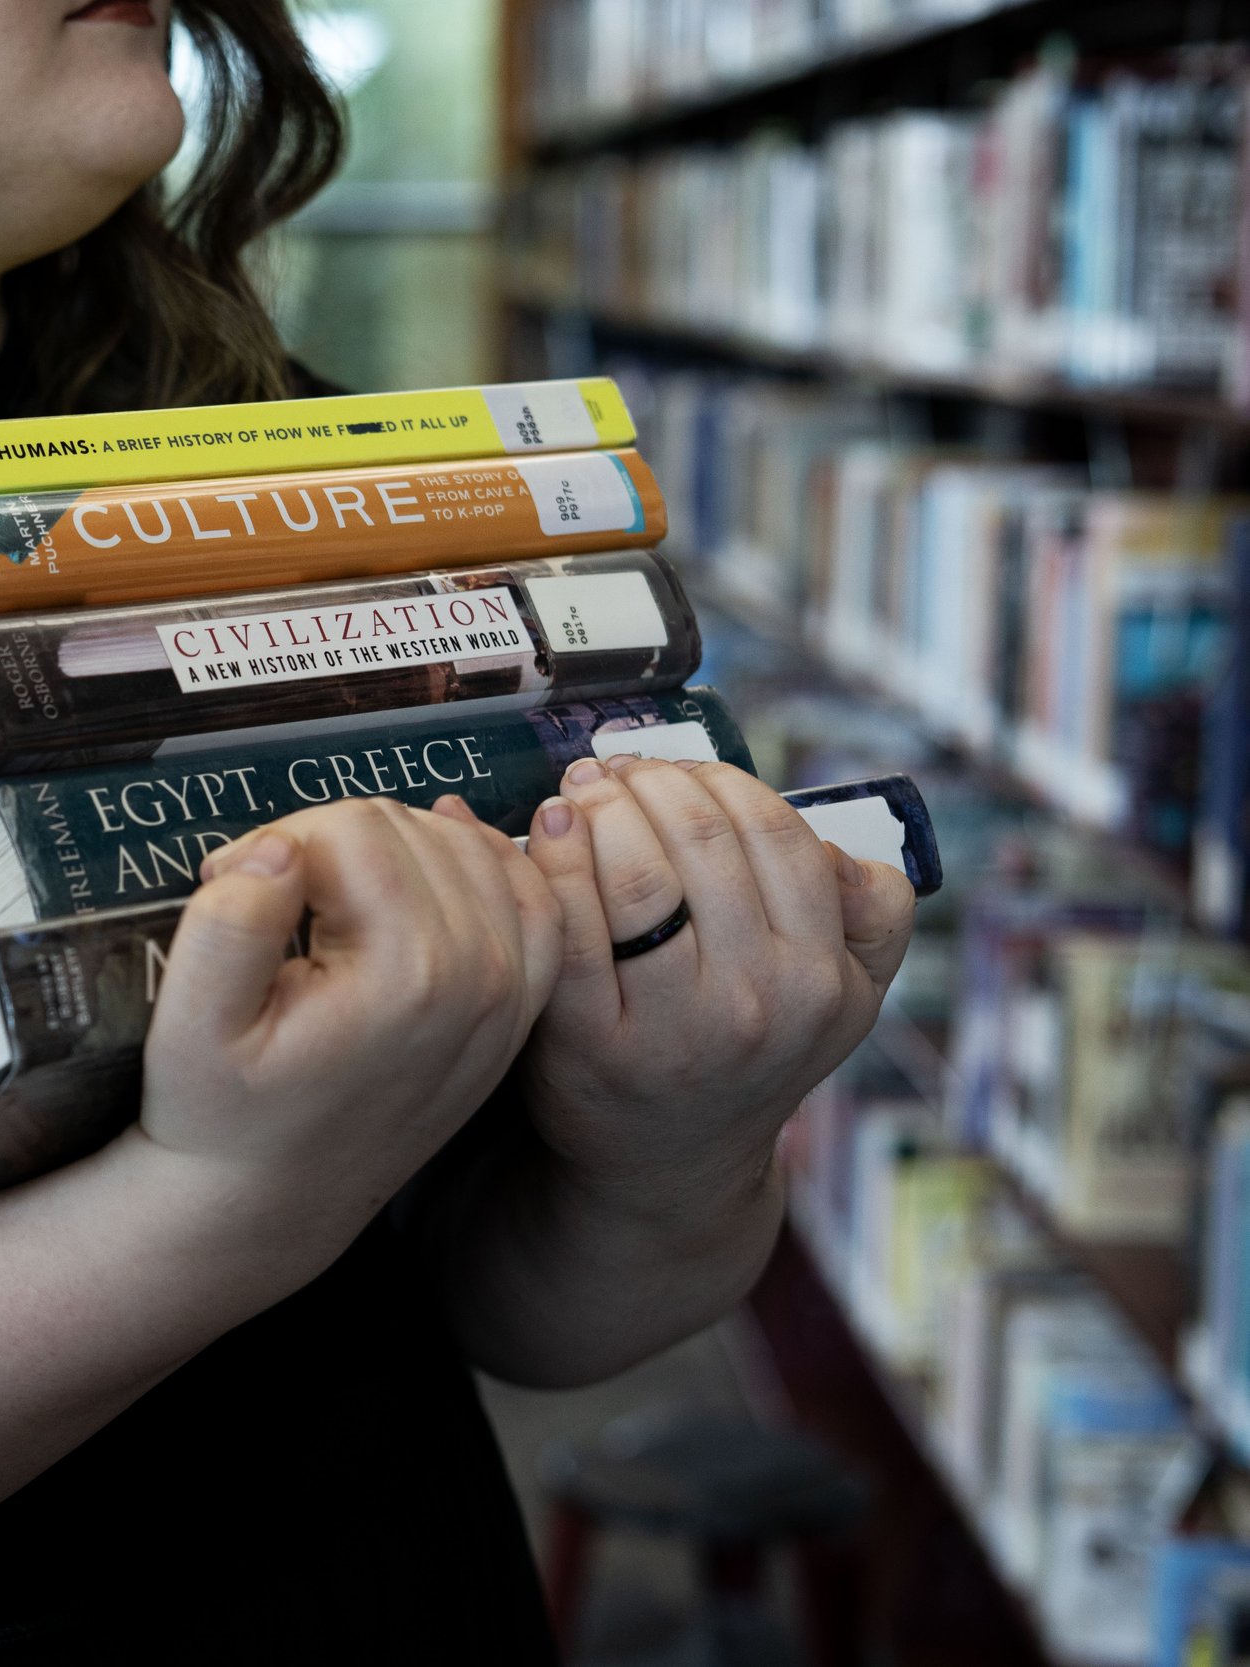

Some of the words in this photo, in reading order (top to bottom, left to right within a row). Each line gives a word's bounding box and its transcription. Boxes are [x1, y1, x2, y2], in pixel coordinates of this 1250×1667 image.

[103, 440, 115, 453] A
[117, 436, 162, 452] BRIEF
[166, 431, 233, 449] HISTORY
[237, 430, 259, 443] OF
[264, 426, 303, 442] HOW
[307, 424, 333, 439] WE
[337, 420, 398, 437] FED
[401, 419, 415, 432] IT
[420, 417, 447, 430] ALL
[449, 415, 469, 428] UP
[516, 422, 533, 445] 909
[415, 475, 450, 487] THE
[452, 470, 502, 485] STORY
[506, 470, 519, 481] O
[425, 489, 471, 503] FROM
[474, 485, 515, 499] CAVE
[5, 501, 41, 566] MARTIN
[18, 495, 60, 574] PUCHNER
[72, 481, 426, 549] CULTURE
[431, 508, 453, 521] TO
[457, 504, 505, 519] K-POP
[556, 496, 570, 521] 909
[173, 596, 510, 658] CIVILIZATION
[562, 622, 578, 645] 909
[12, 632, 59, 719] OSBORNE
[188, 666, 201, 684] A
[205, 661, 242, 681] NEW
[248, 652, 318, 676] HISTORY
[324, 650, 343, 667] OF
[349, 645, 383, 664] THE
[386, 635, 463, 660] WESTERN
[466, 629, 520, 650] WORLD
[85, 767, 275, 833] EGYPT,
[288, 736, 493, 803] GREECE
[29, 782, 96, 915] FREEMAN
